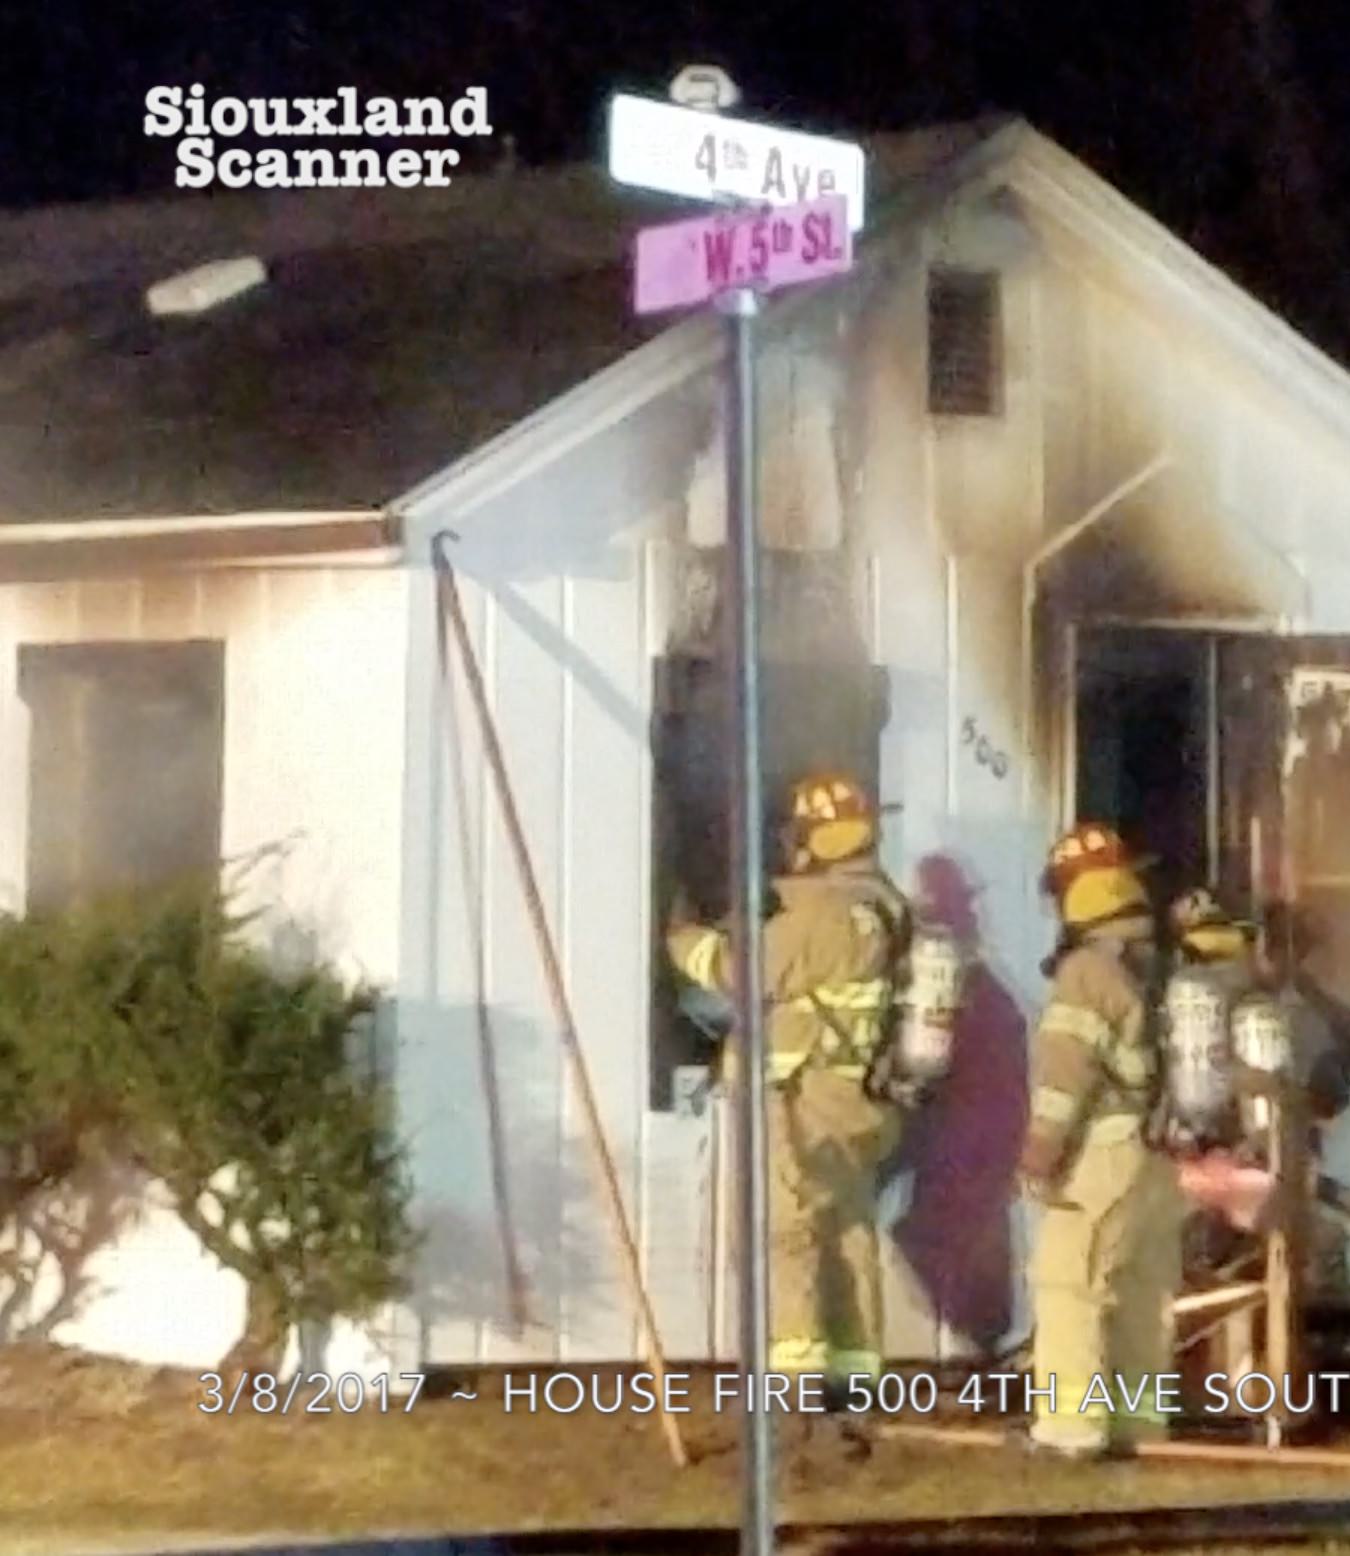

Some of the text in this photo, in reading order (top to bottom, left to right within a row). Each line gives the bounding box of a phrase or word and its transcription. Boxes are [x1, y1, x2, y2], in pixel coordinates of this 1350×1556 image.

[695, 134, 836, 200] 4th Ave
[961, 715, 1008, 780] 500
